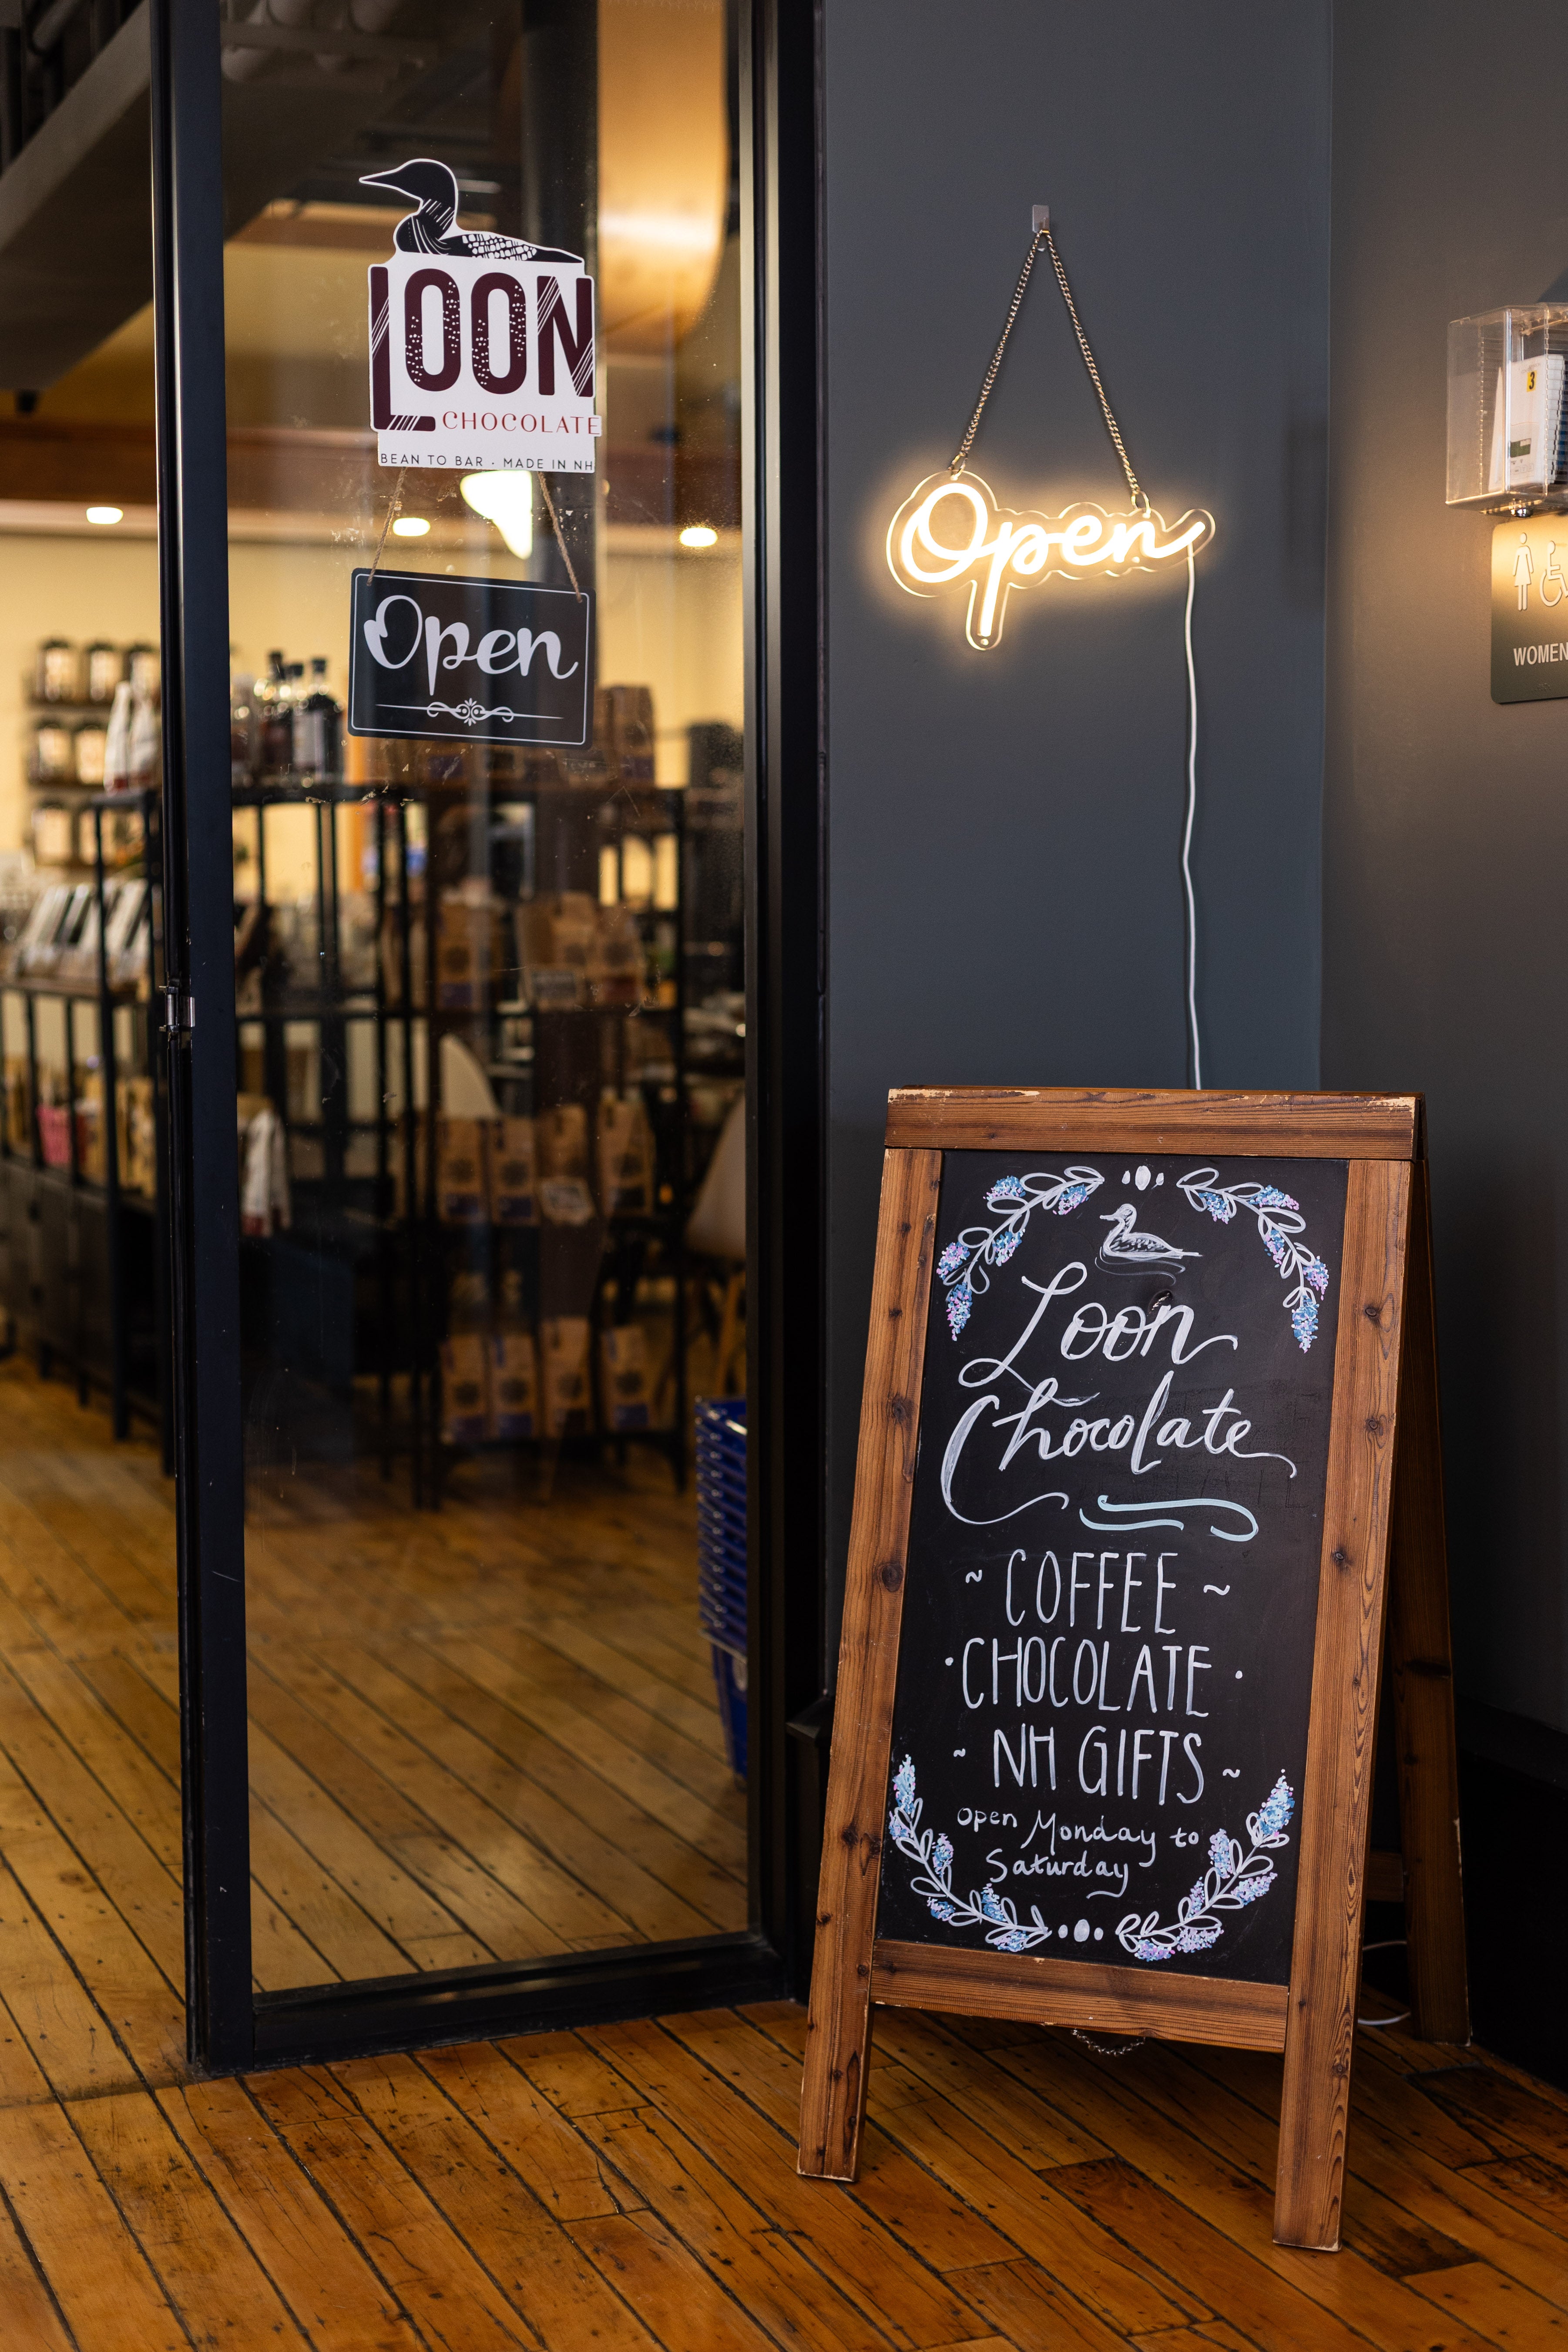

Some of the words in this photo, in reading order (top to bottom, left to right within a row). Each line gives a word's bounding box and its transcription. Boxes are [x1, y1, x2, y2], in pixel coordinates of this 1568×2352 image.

[371, 266, 593, 431] LOON
[1529, 371, 1535, 390] 3
[380, 453, 420, 464] BEAN
[427, 455, 447, 466] TO
[455, 456, 483, 467] BAR
[503, 457, 544, 469] MADE
[552, 459, 566, 470] IN
[574, 460, 593, 470] NH
[442, 411, 600, 435] CHOCOLATE
[901, 482, 1206, 638] Open
[363, 595, 578, 696] Open
[1513, 642, 1568, 666] WOMEN
[958, 1262, 1239, 1407] Loon
[940, 1371, 1298, 1525] Chocolate
[1006, 1549, 1179, 1634] COFFEE
[962, 1636, 1212, 1717] CHOCOLATE
[994, 1723, 1056, 1791] NH
[1078, 1725, 1204, 1806] GIFTS
[986, 1848, 1128, 1899] Saturday
[1021, 1809, 1155, 1867] Monday
[1169, 1827, 1199, 1848] to
